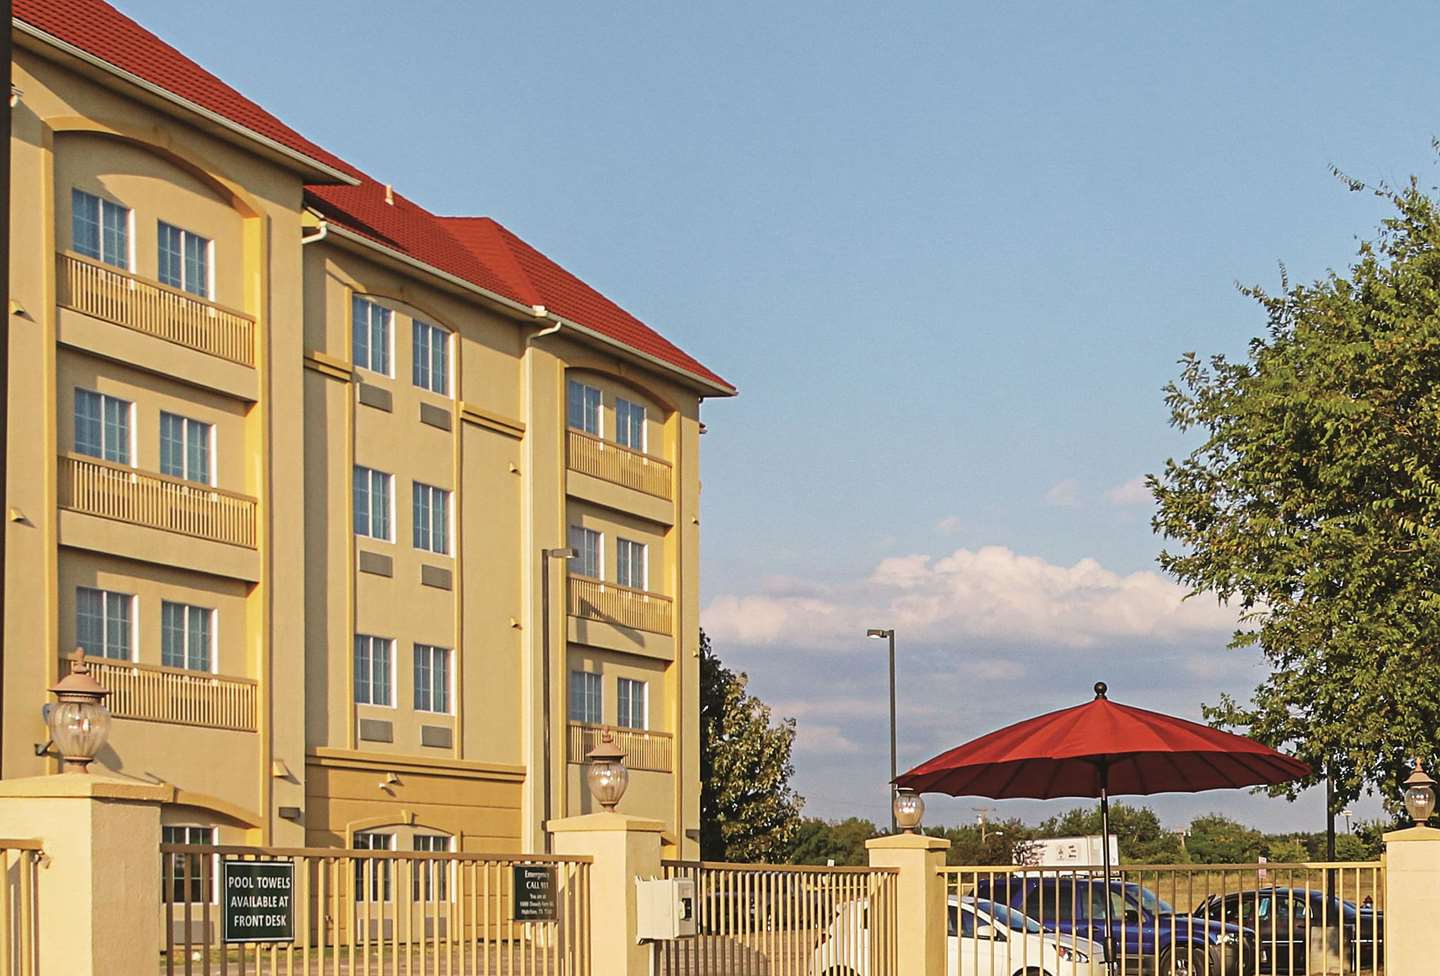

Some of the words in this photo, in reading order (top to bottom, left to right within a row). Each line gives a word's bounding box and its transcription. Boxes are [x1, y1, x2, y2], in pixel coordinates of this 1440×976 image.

[228, 876, 254, 889] POOL
[257, 876, 291, 889] TOWELS
[526, 881, 540, 889] CALL
[230, 895, 278, 908] AVAILABLE
[278, 895, 289, 908] AT
[233, 915, 264, 927] FRONT
[265, 915, 287, 927] DESK
